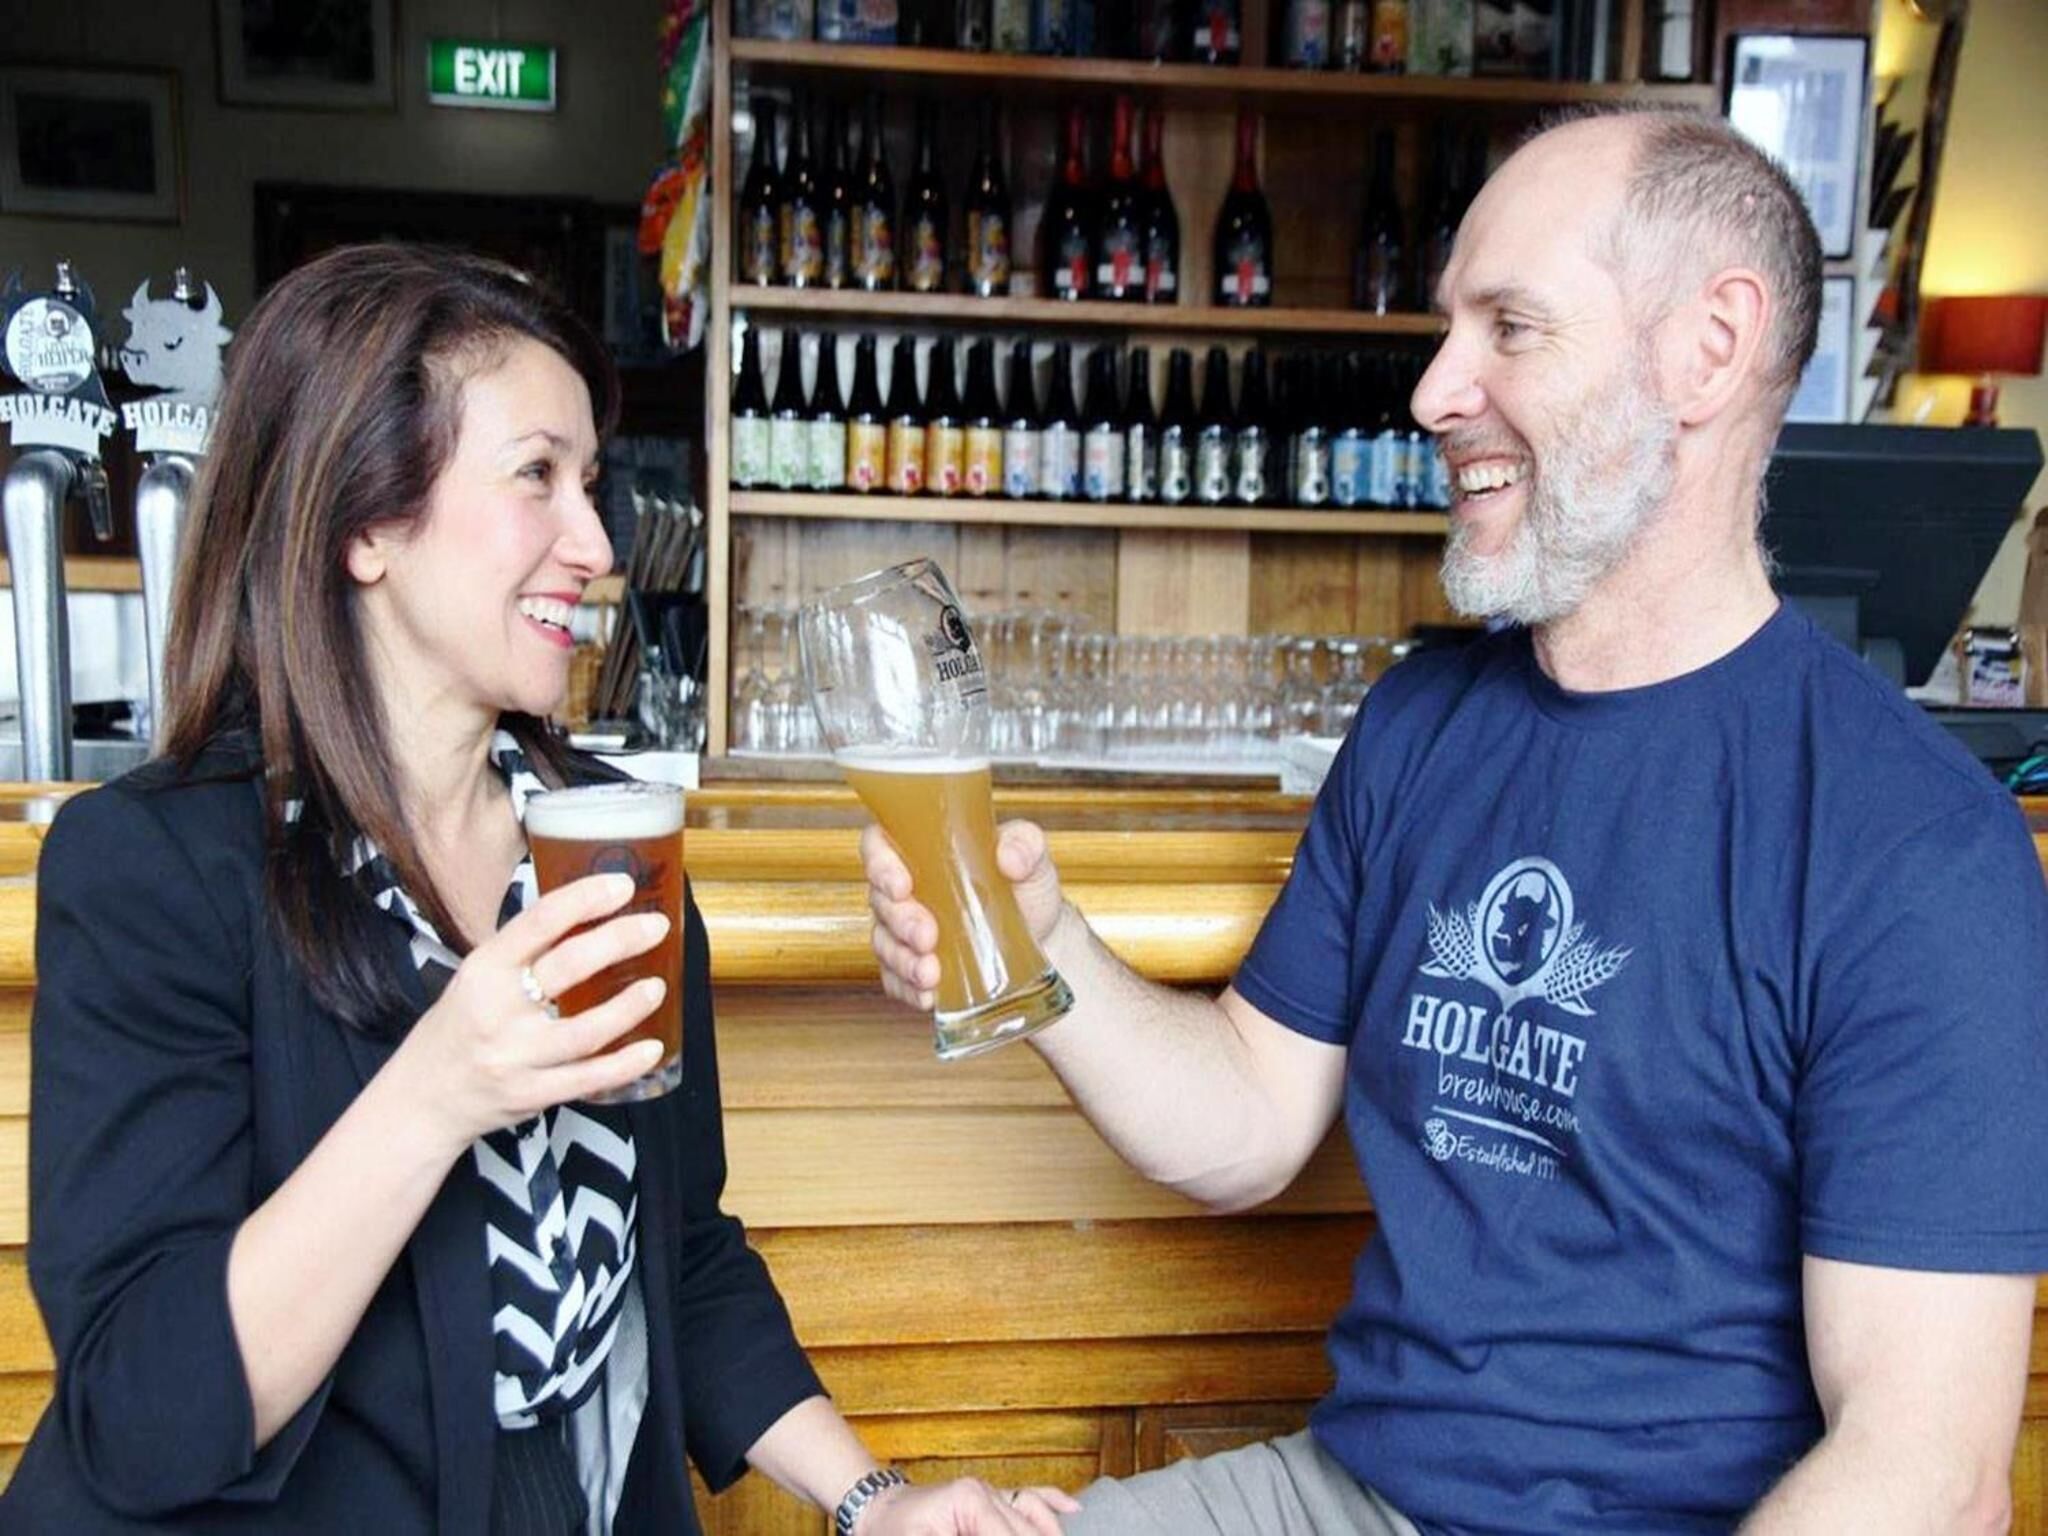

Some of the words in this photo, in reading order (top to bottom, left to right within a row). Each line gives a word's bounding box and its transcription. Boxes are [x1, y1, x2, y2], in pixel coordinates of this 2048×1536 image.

[454, 48, 526, 97] EXIT
[0, 393, 118, 438] HOLGATE
[121, 401, 209, 433] HOLGA
[1402, 994, 1586, 1098] HOLGATE
[1457, 1135, 1536, 1177] Established
